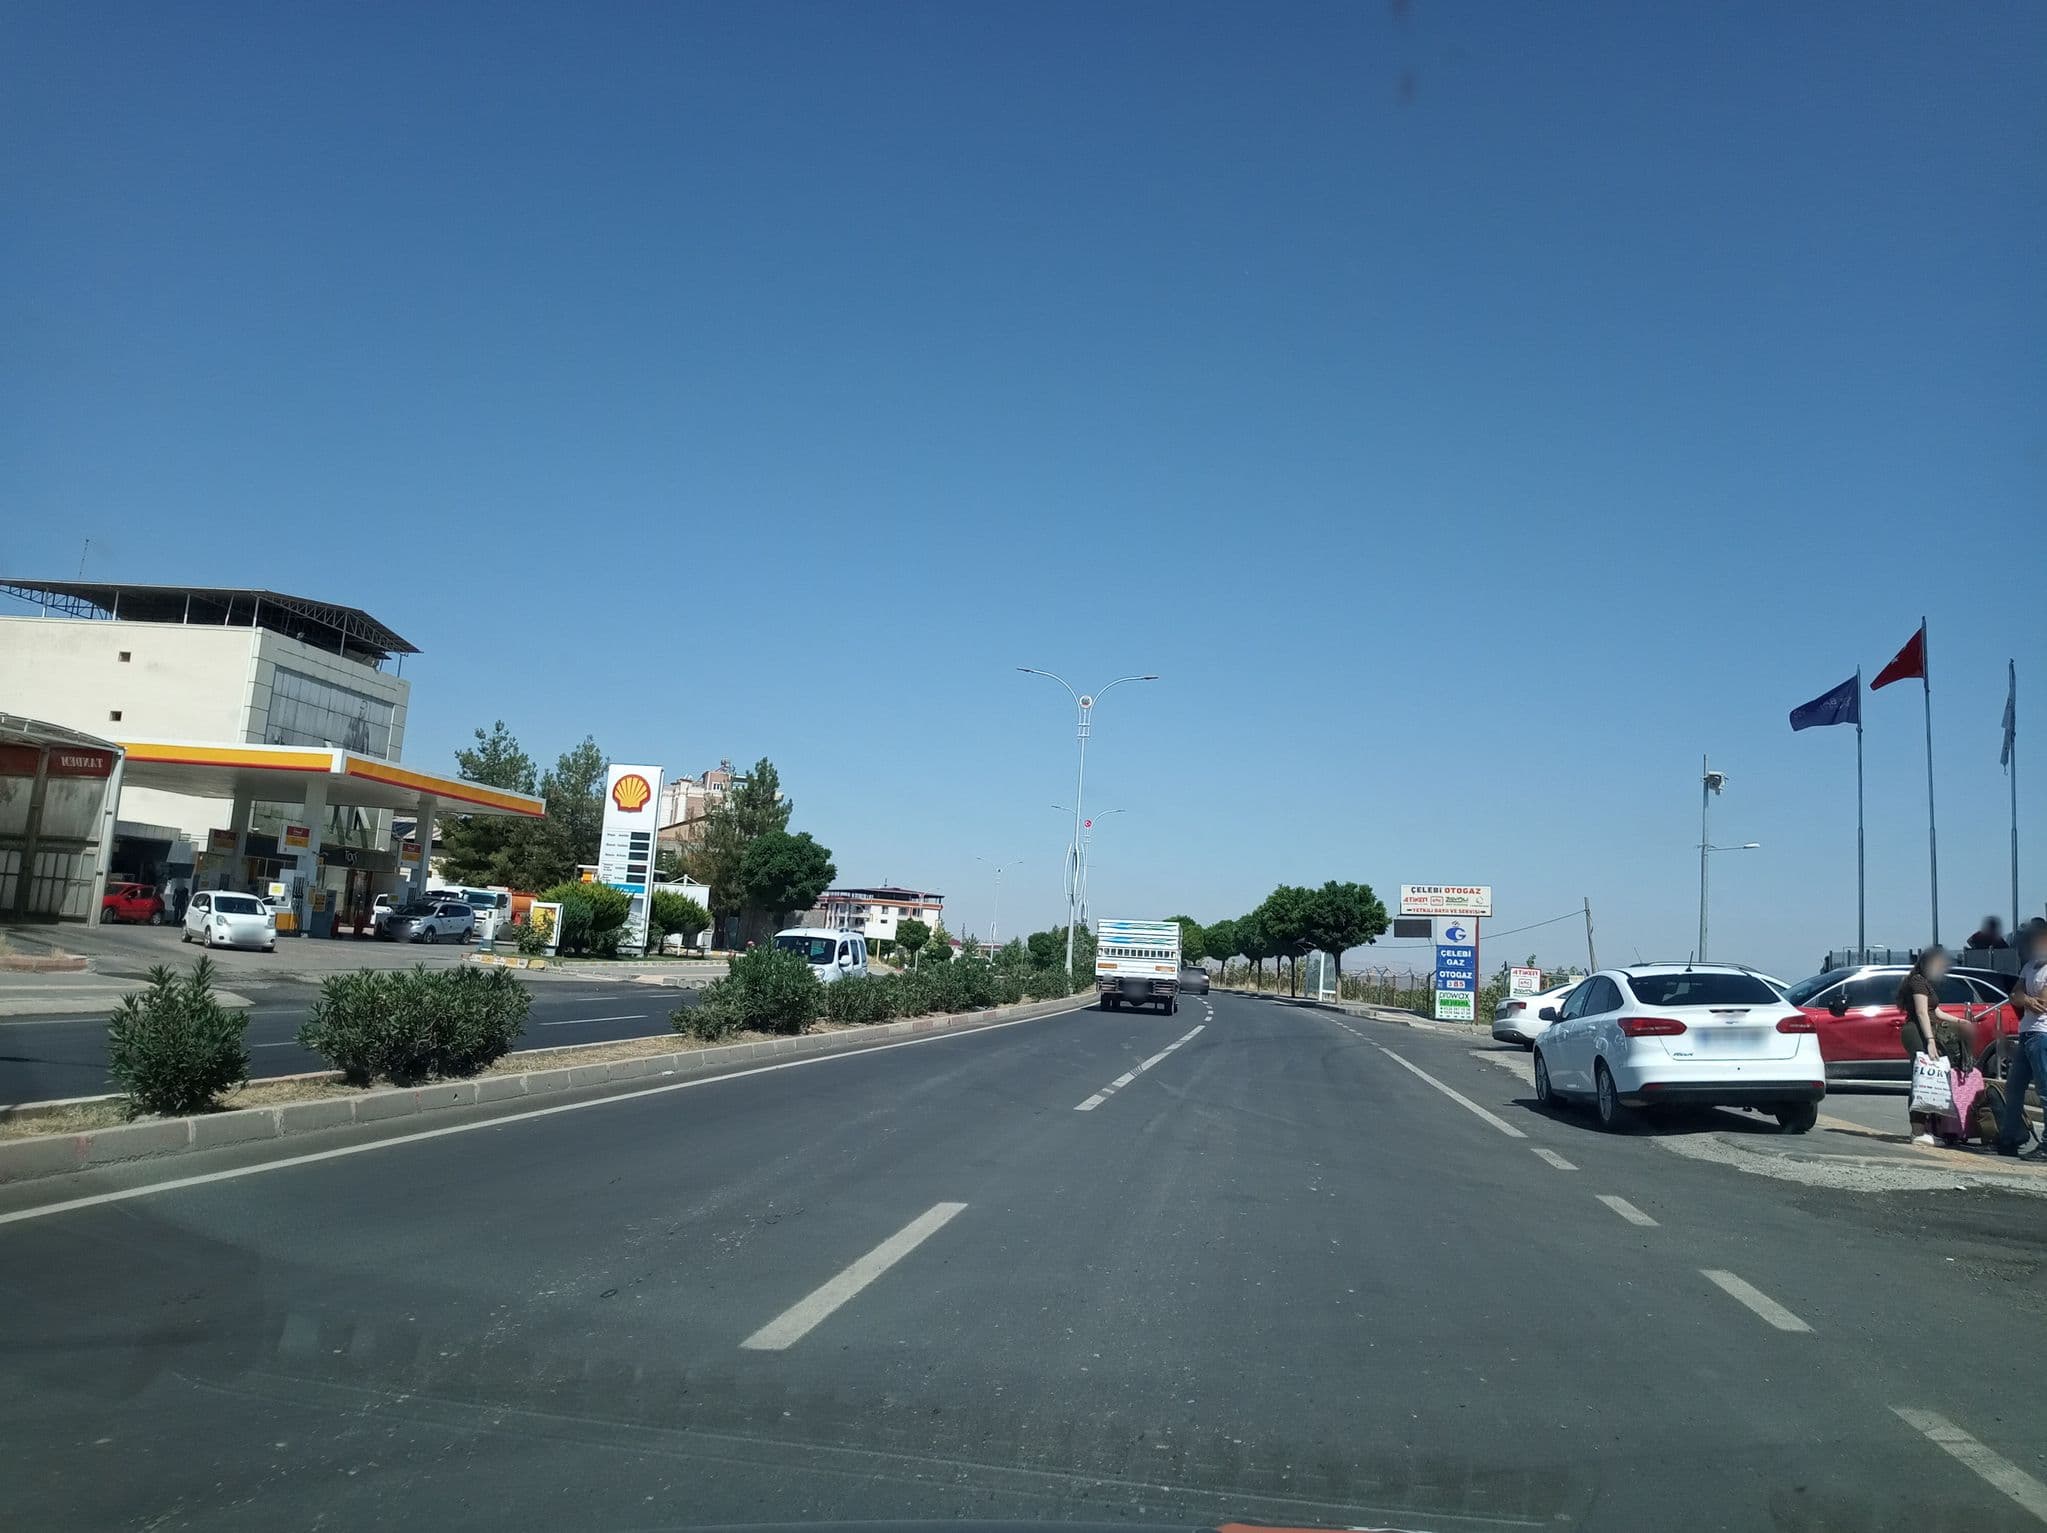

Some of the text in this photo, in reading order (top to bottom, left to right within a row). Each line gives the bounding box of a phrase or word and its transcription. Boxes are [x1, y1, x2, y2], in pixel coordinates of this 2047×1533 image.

[1411, 886, 1482, 895] ÇELEBİ OTOGAZ
[1441, 949, 1472, 958] ÇELEBİ
[1439, 970, 1473, 979] OTOGAZ
